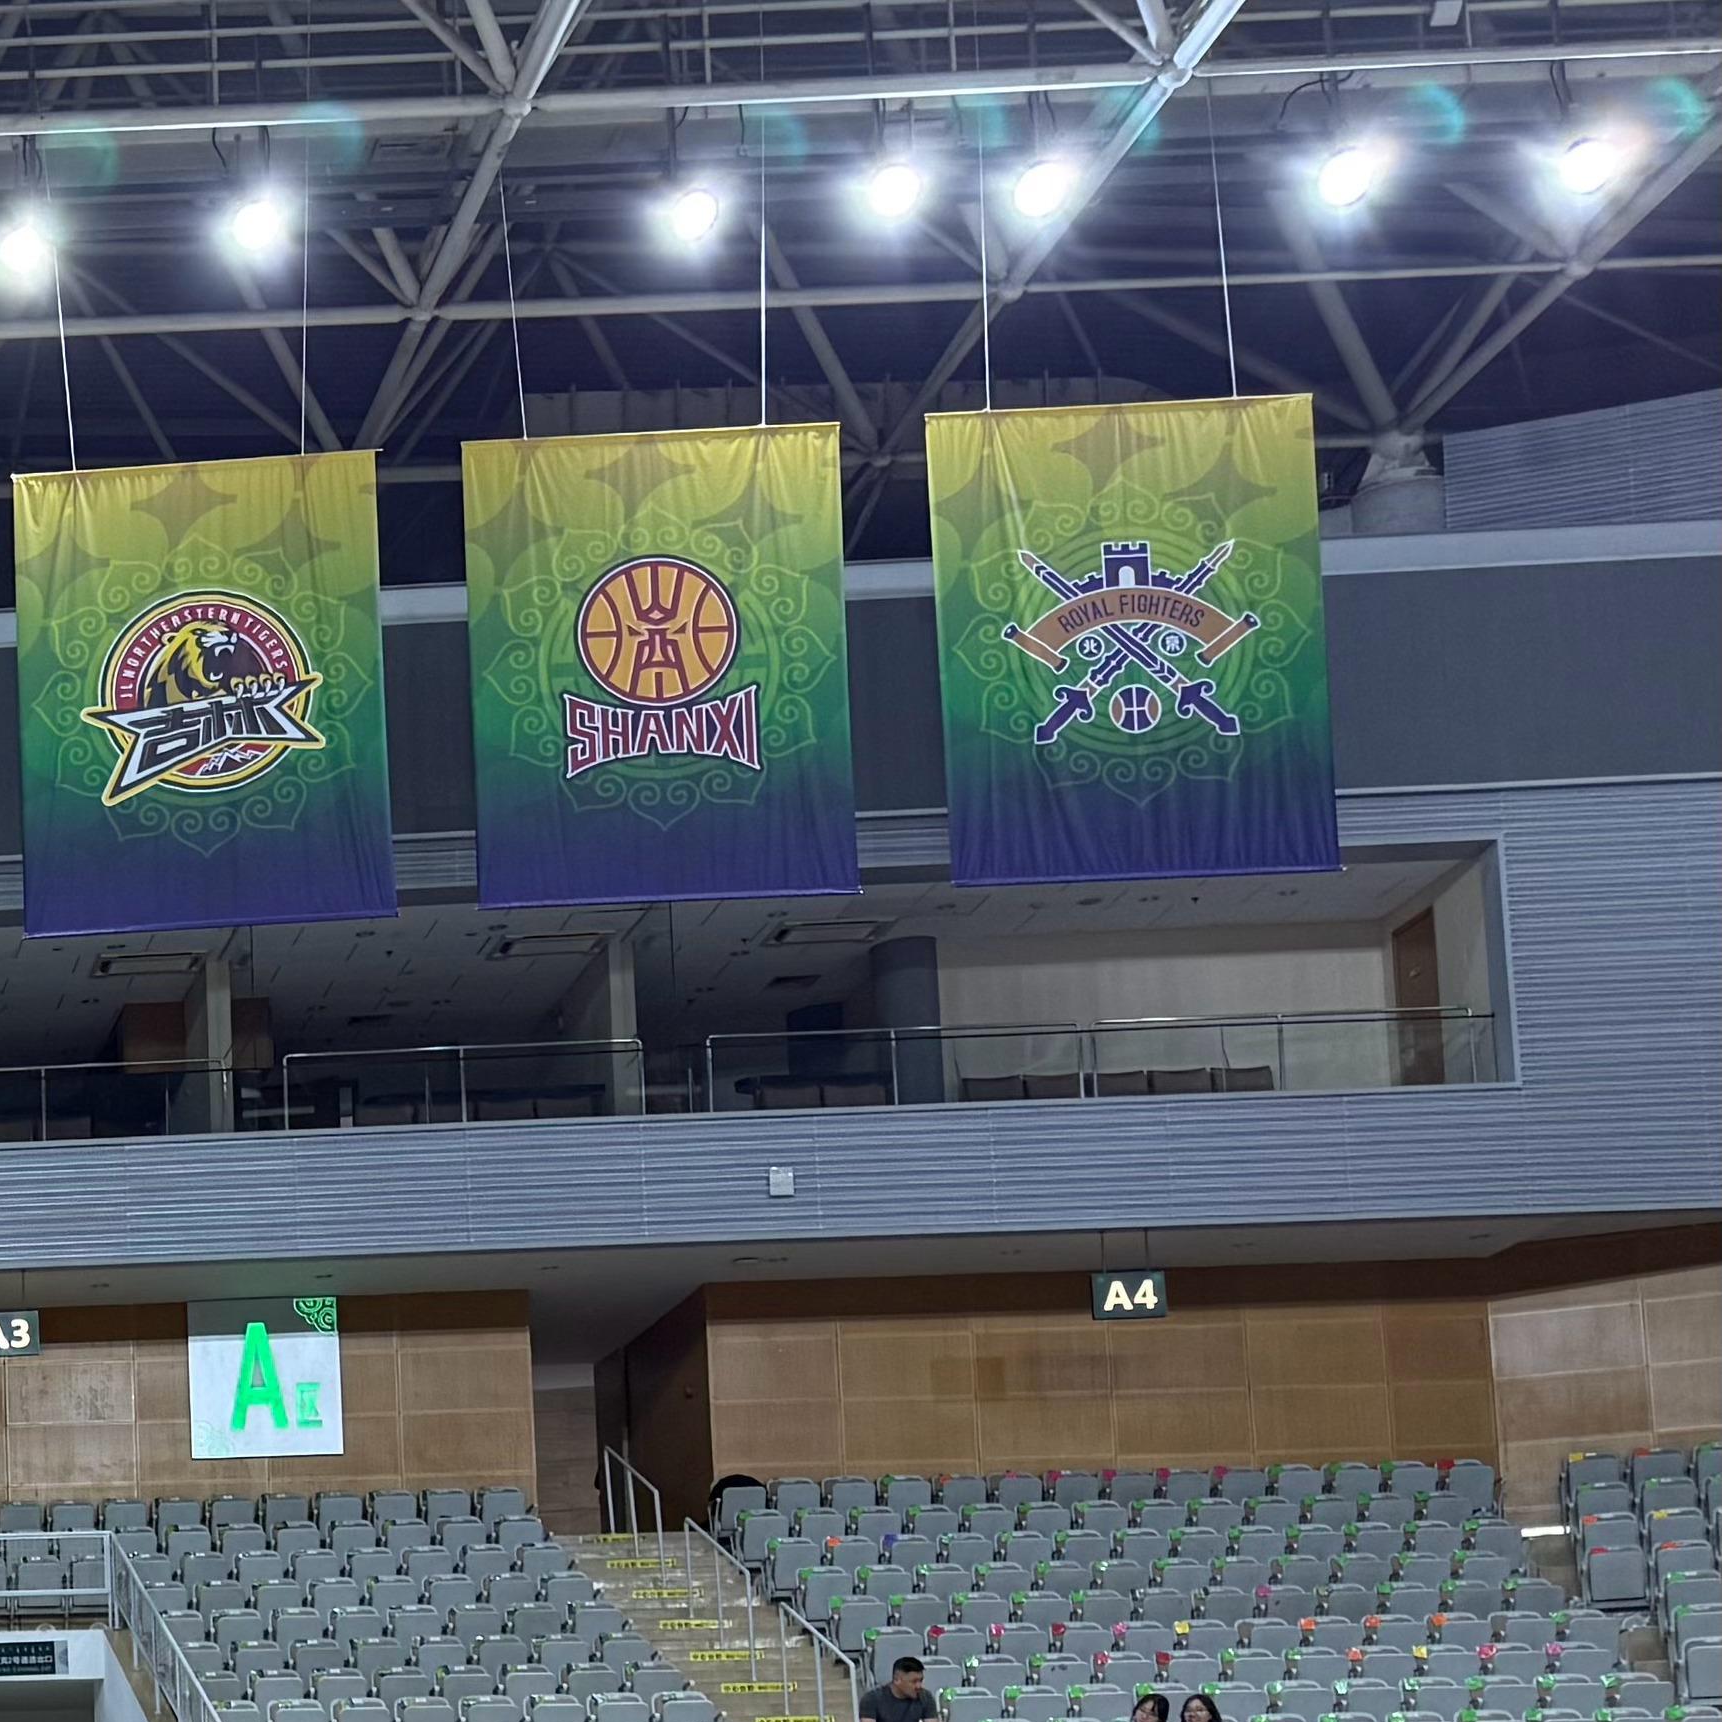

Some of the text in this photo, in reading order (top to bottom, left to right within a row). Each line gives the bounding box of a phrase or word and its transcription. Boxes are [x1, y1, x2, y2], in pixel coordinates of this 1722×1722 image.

[1058, 594, 1206, 634] ROYAL FIGHTERS
[563, 685, 761, 779] SHANXI
[1103, 1279, 1159, 1311] A4
